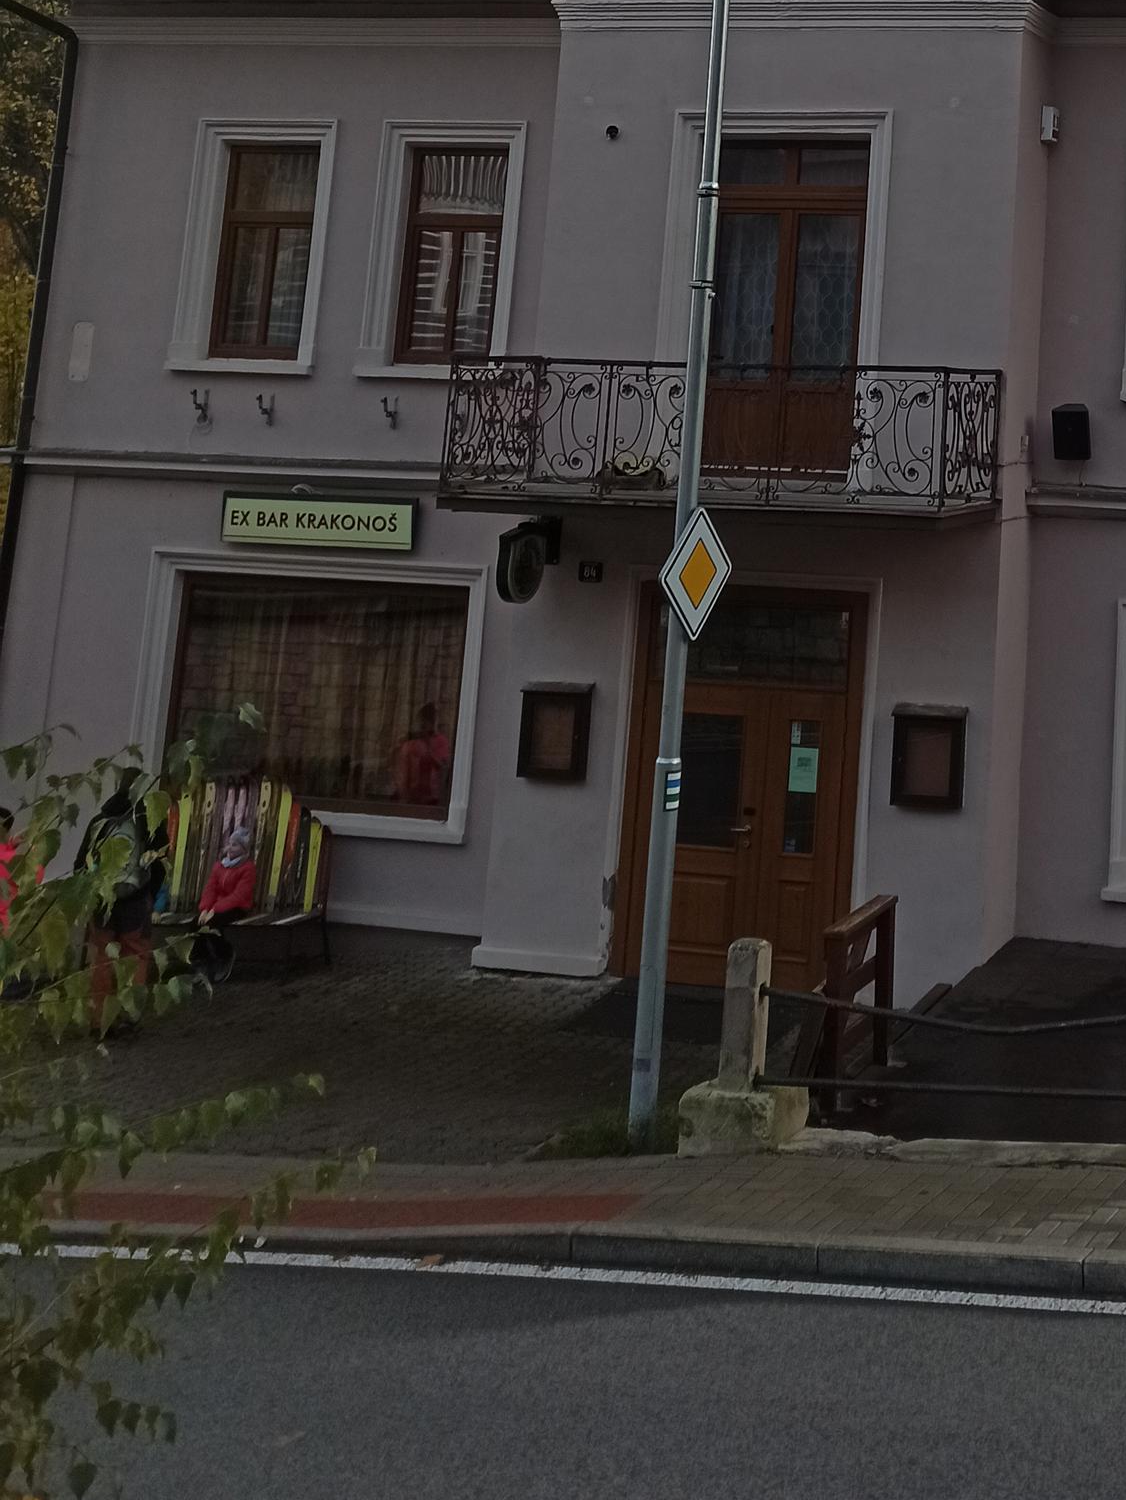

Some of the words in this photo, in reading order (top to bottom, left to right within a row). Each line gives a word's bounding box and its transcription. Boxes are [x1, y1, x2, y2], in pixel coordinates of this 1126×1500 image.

[230, 510, 250, 526] EX
[256, 511, 289, 528] BAR
[295, 512, 398, 533] KRAKONOŠ
[584, 566, 596, 577] 84
